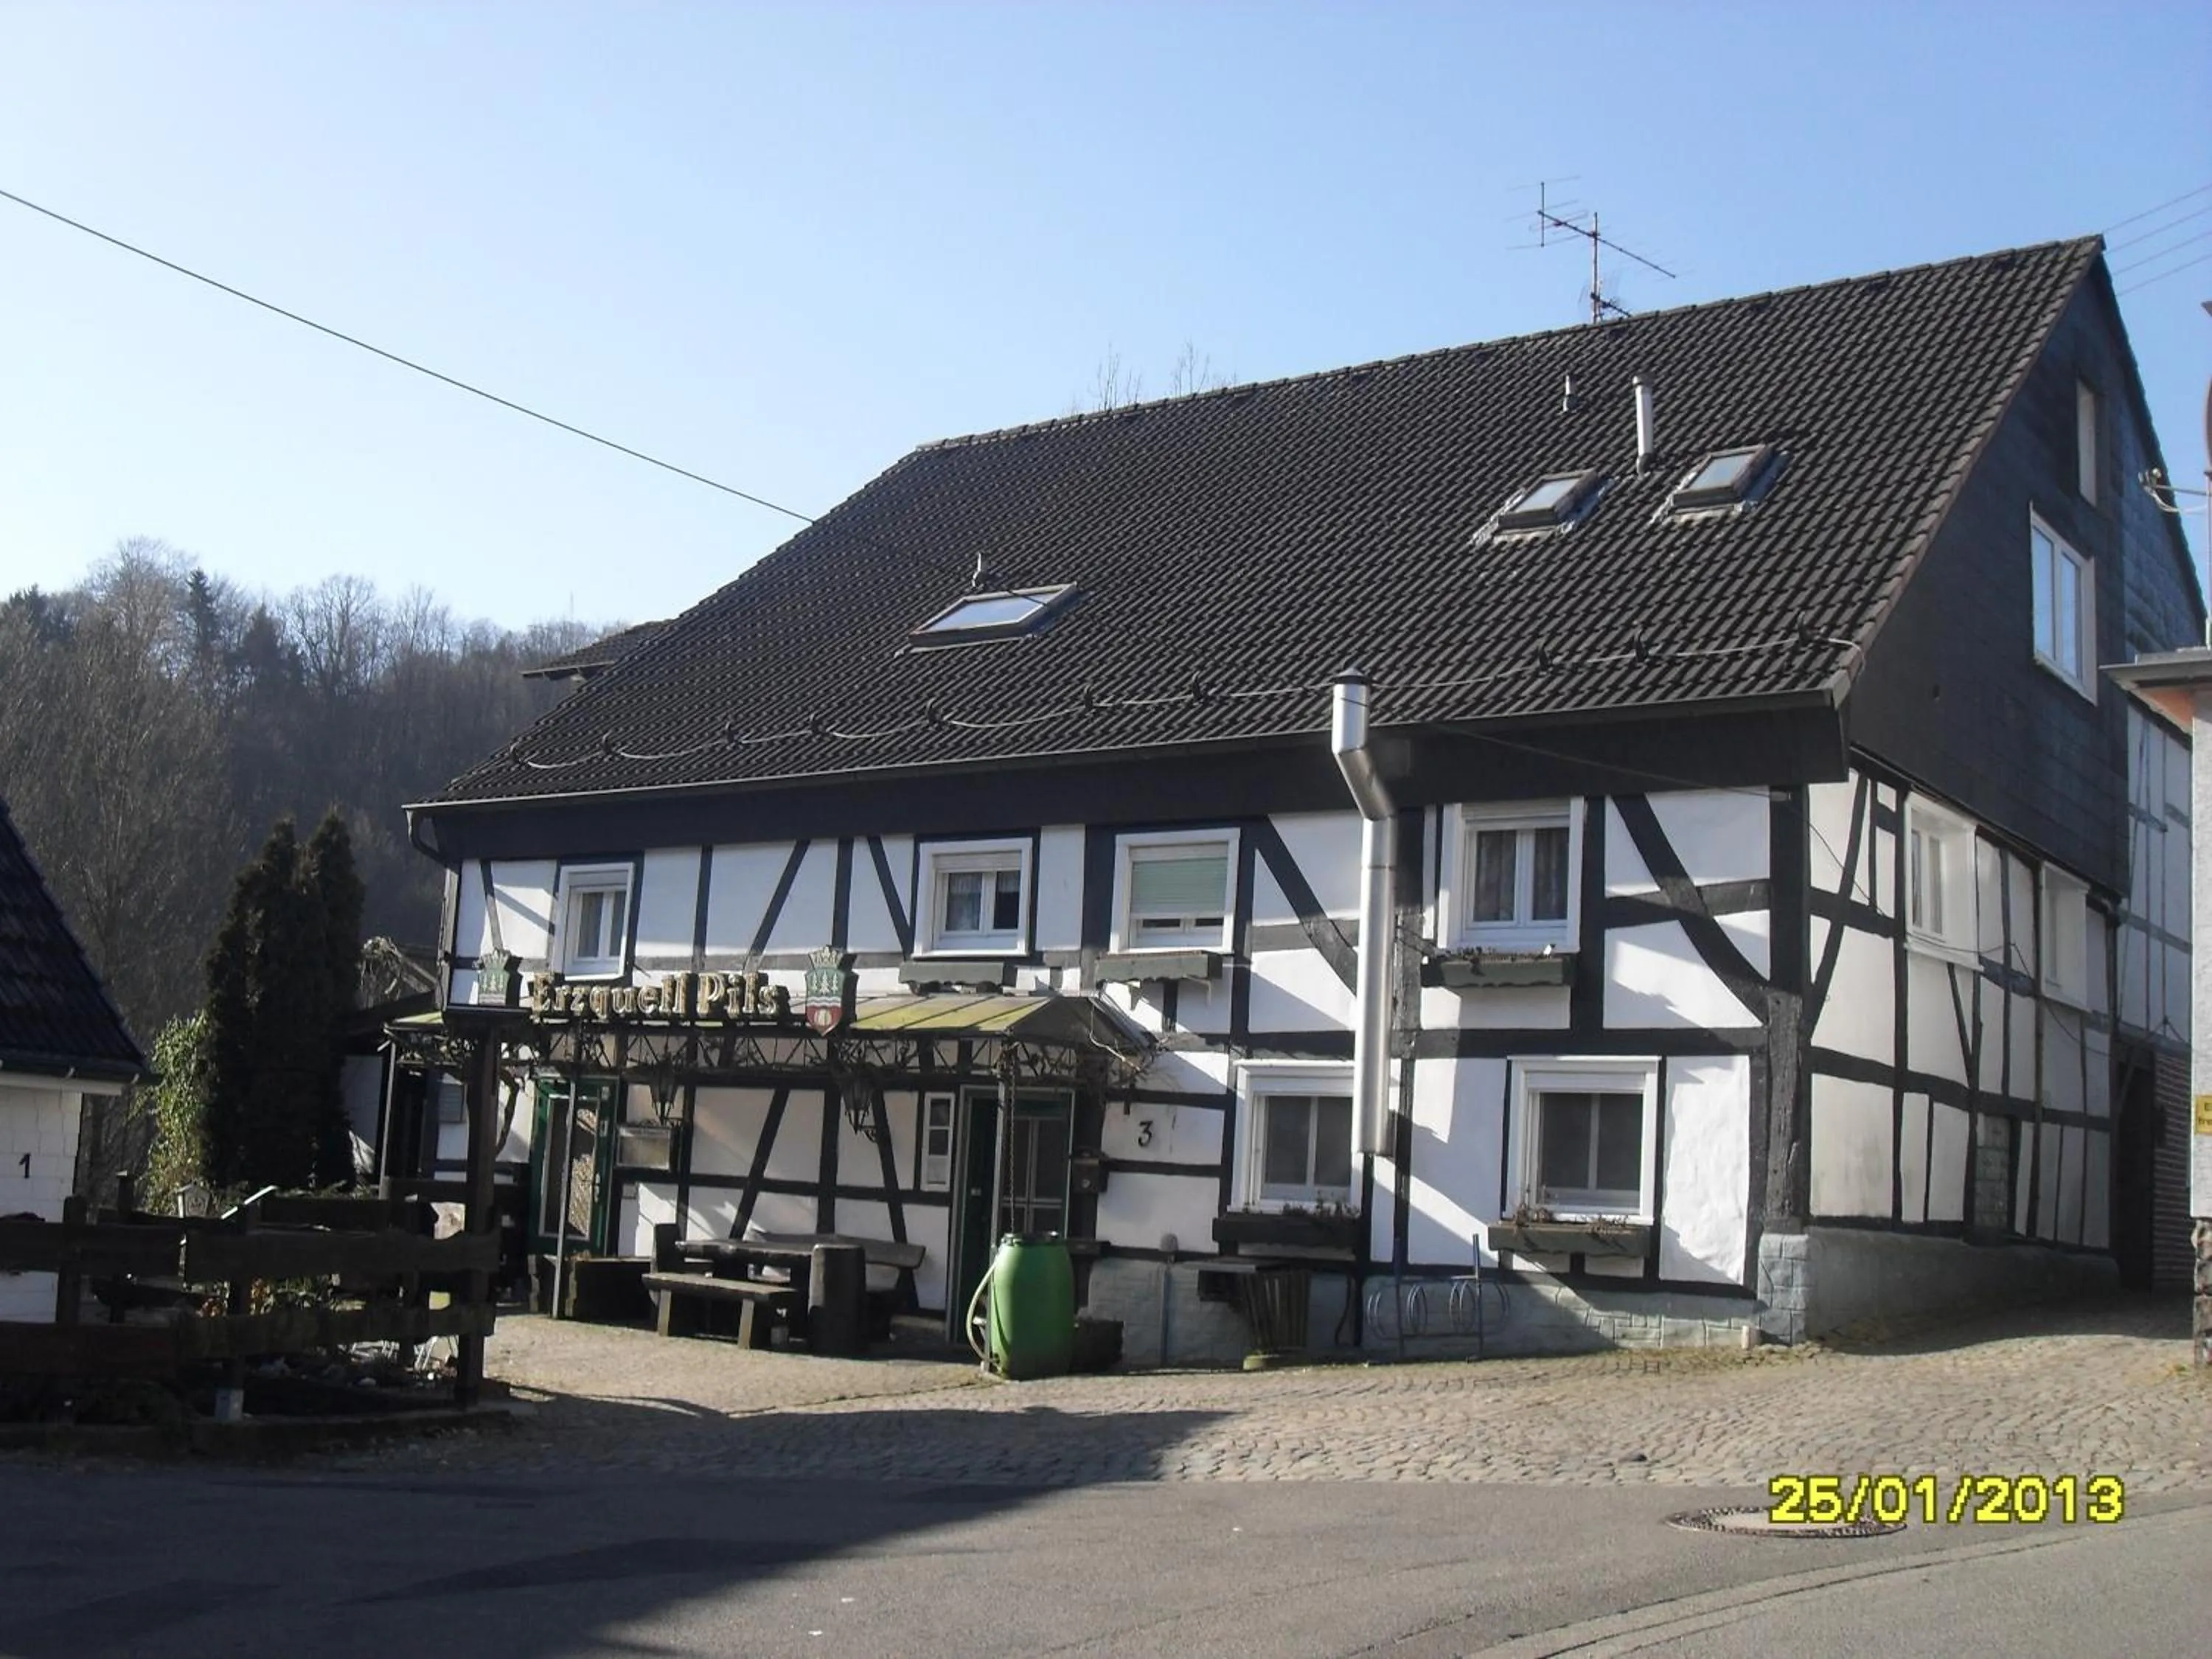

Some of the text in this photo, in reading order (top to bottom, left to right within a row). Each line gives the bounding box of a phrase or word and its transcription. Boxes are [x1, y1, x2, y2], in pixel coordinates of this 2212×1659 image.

[532, 971, 779, 1020] Erzquell Pils
[1138, 1120, 1153, 1147] 3
[19, 1152, 31, 1179] 1
